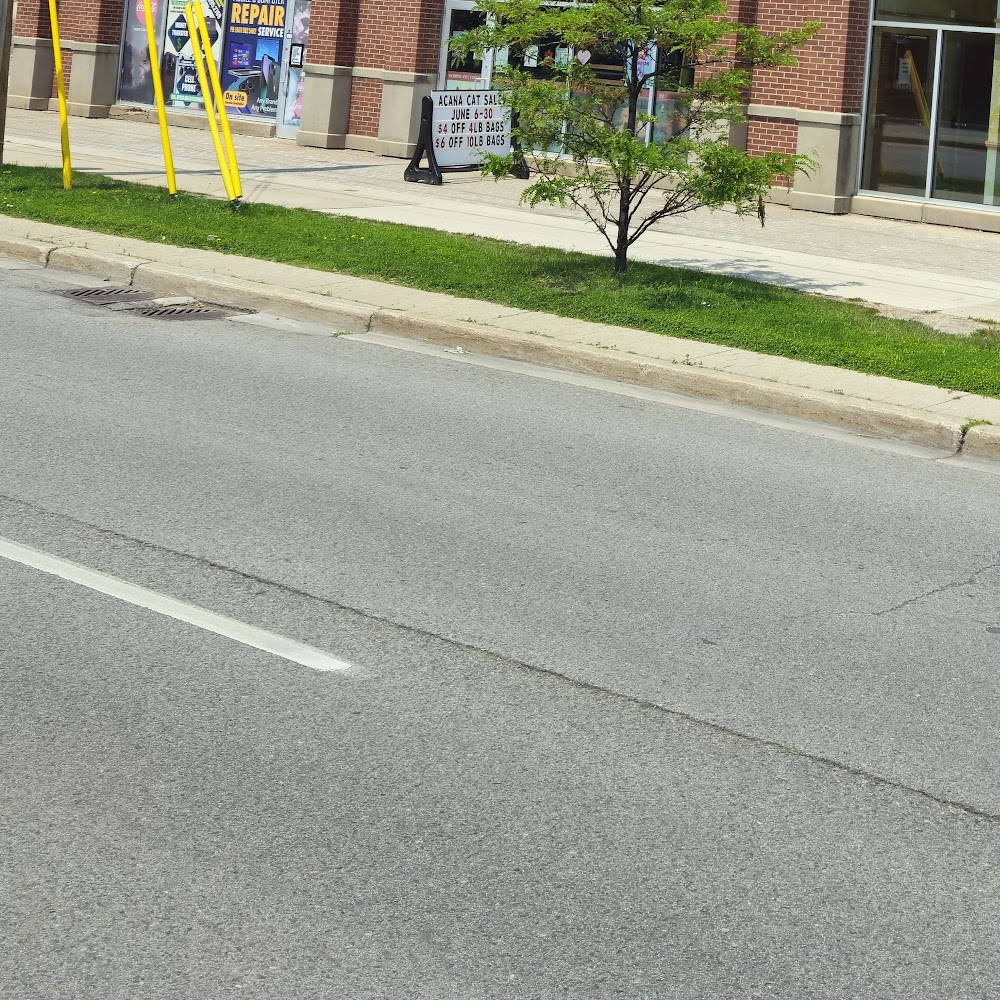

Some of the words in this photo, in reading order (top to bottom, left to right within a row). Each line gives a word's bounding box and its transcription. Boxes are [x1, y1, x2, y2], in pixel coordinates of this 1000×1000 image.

[231, 2, 285, 26] REPAIR
[258, 26, 284, 37] SERVICE
[226, 92, 233, 100] On
[235, 93, 245, 101] site
[439, 95, 462, 106] ACANA
[466, 95, 480, 105] CAT
[451, 109, 469, 120] JUNE
[474, 108, 493, 119] 6-30
[438, 123, 447, 134] $4
[451, 123, 465, 134] OFF
[469, 122, 482, 133] 4LB
[486, 122, 504, 132] BAGS
[436, 137, 445, 148] $6
[449, 137, 463, 148] OFF
[467, 135, 483, 147] 10LB
[487, 135, 504, 146] BAGS
